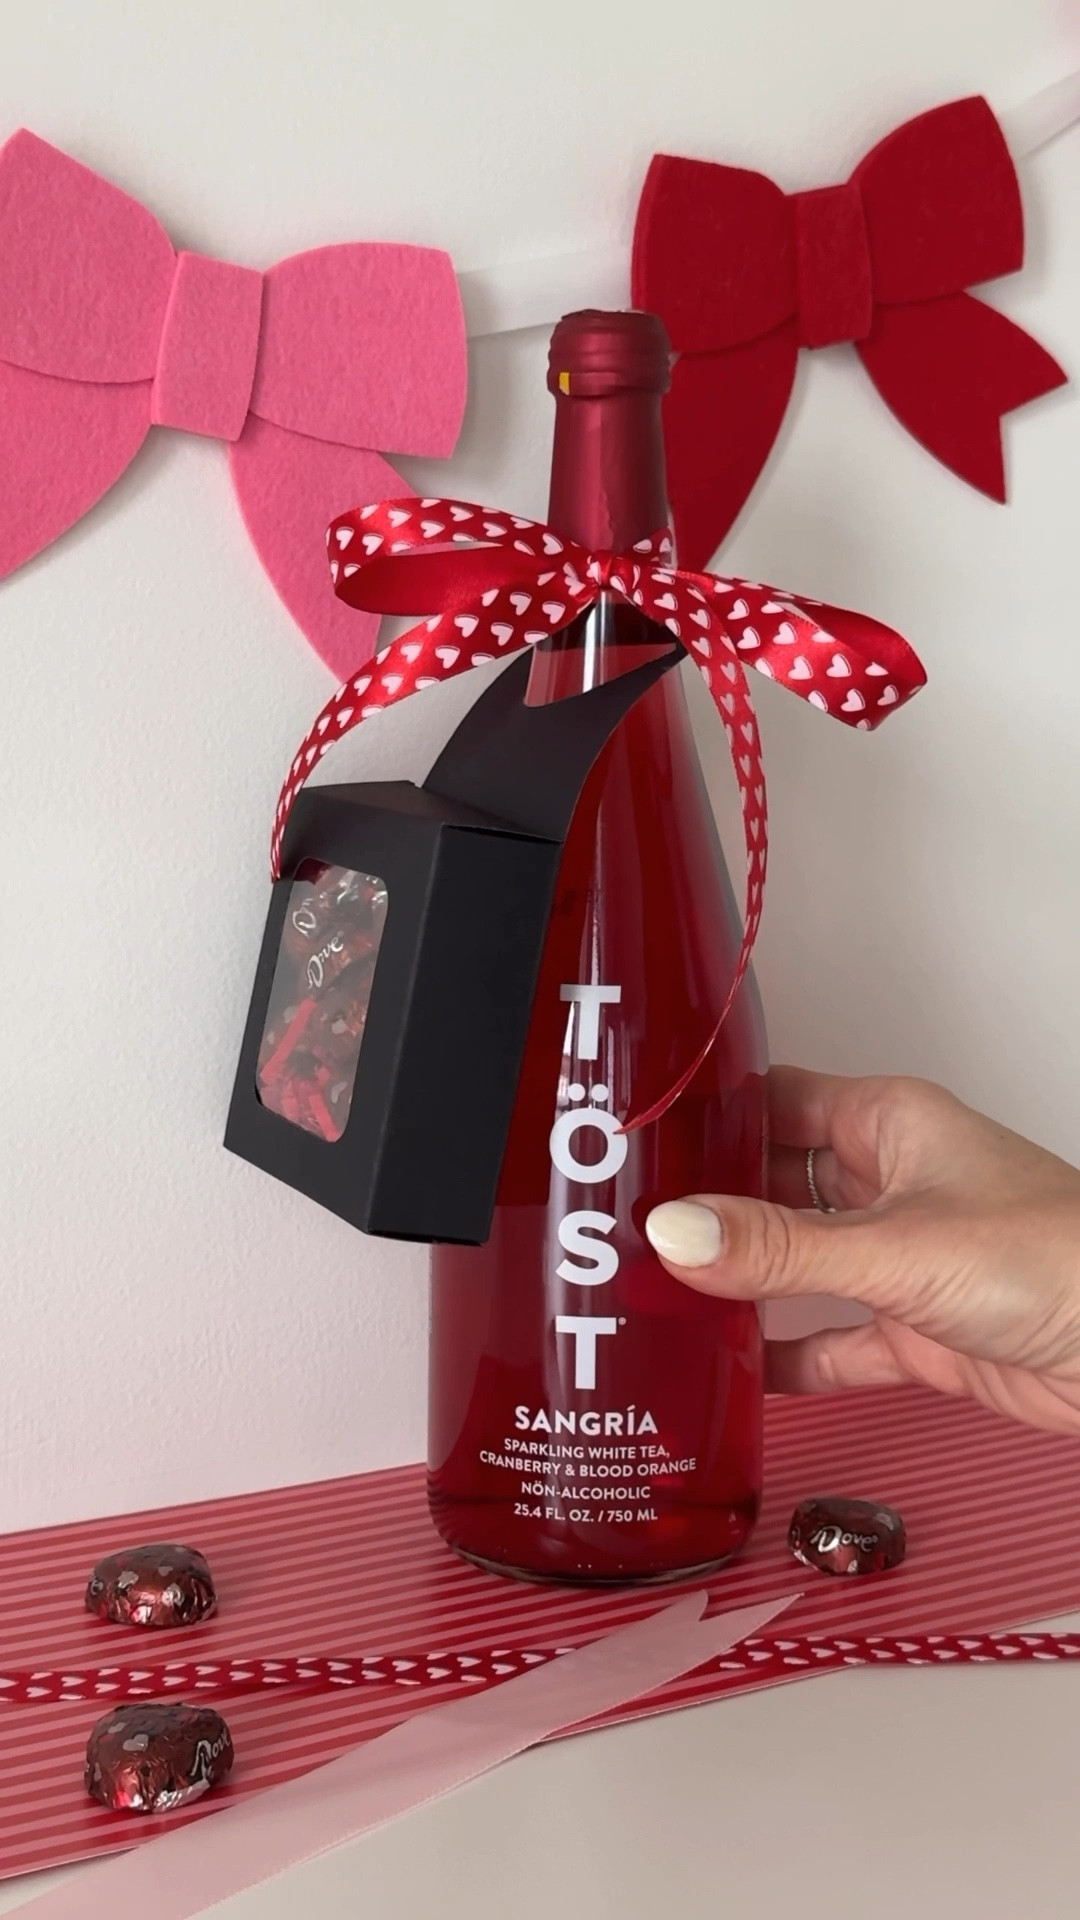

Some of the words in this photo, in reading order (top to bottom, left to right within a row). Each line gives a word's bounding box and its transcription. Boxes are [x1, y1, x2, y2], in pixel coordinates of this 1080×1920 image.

[515, 1404, 658, 1436] SANGRÍA
[504, 1438, 584, 1459] SPARKLING
[588, 1446, 636, 1459] WHITE
[639, 1445, 670, 1458] TEA,
[479, 1450, 561, 1475] CRANBERRY
[565, 1464, 575, 1476] &
[579, 1464, 633, 1477] BLOOD
[637, 1458, 696, 1476] ORANGE
[521, 1480, 651, 1500] NÖN-ALCOHOLIC
[514, 1503, 542, 1518] 25.4
[545, 1507, 566, 1521] FL.
[569, 1509, 594, 1522] OZ.
[597, 1510, 604, 1522] /
[607, 1510, 633, 1522] 750
[636, 1508, 658, 1521] ML
[810, 1525, 878, 1552] Dove
